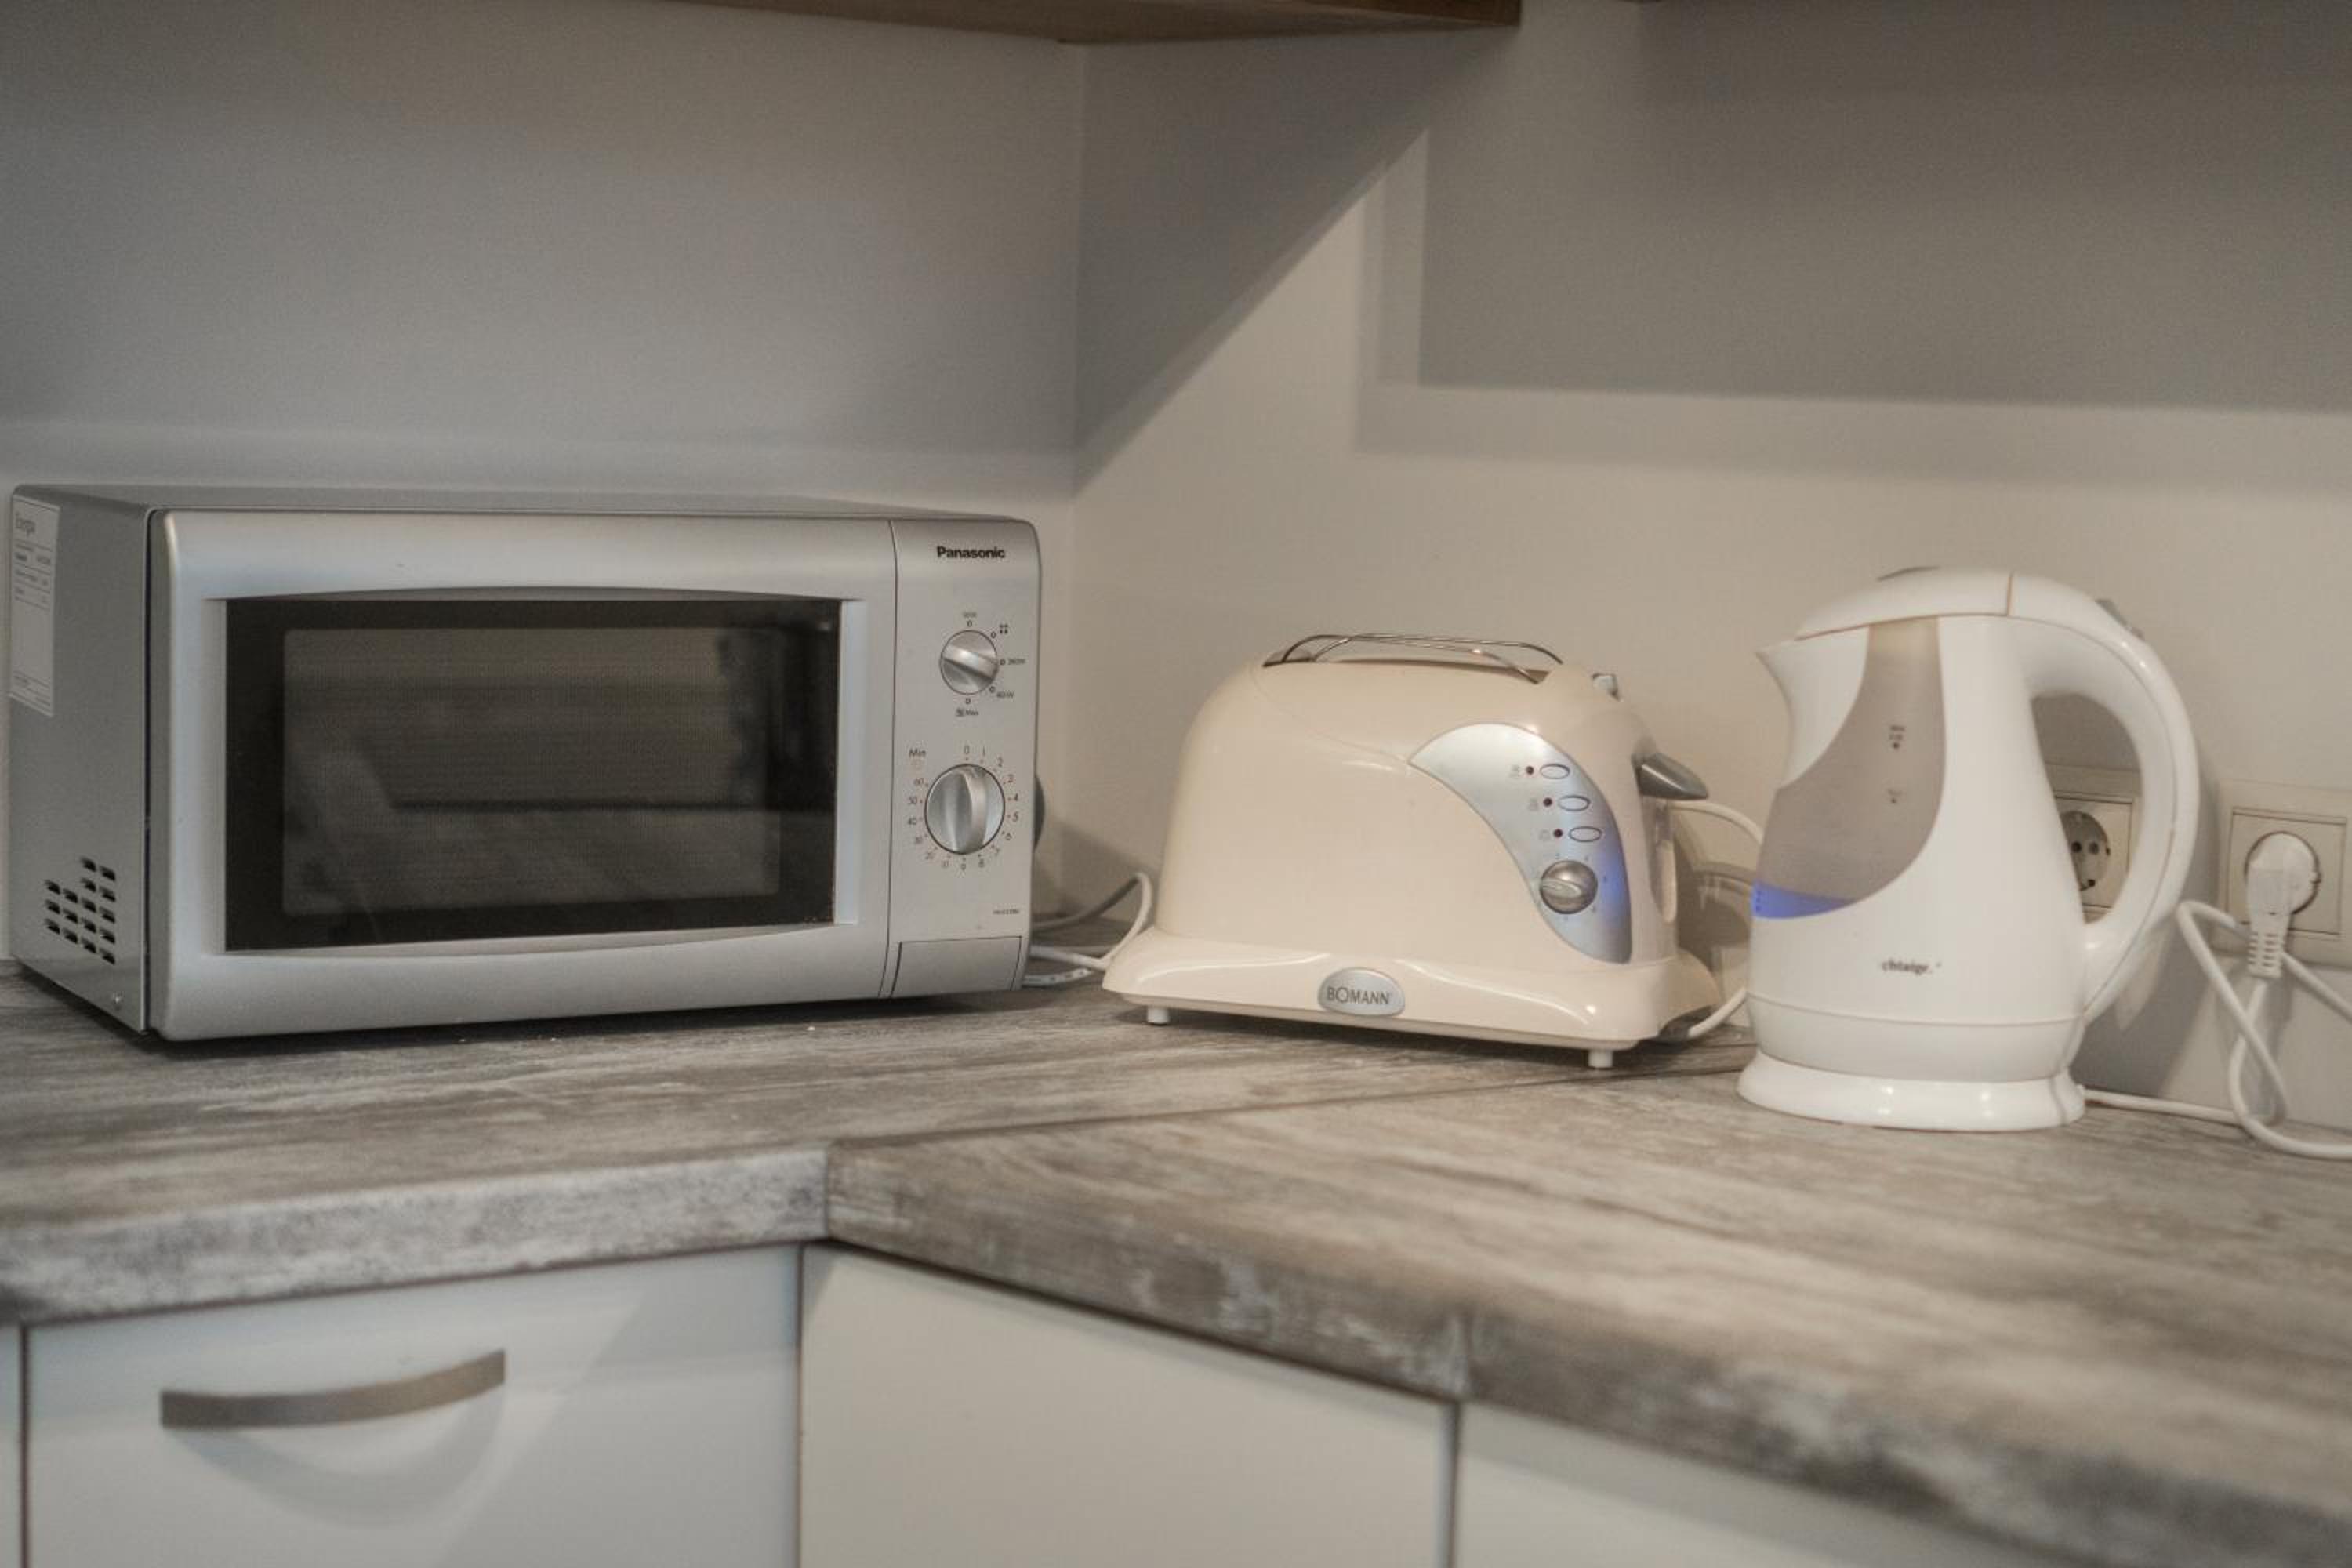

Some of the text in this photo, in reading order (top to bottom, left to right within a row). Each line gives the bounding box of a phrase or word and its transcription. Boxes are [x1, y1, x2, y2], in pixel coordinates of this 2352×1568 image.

[937, 546, 1006, 558] Panasonic
[909, 749, 927, 757] Min
[963, 746, 970, 755] 0
[1012, 813, 1019, 822] 5
[1327, 986, 1389, 1004] BOMANN
